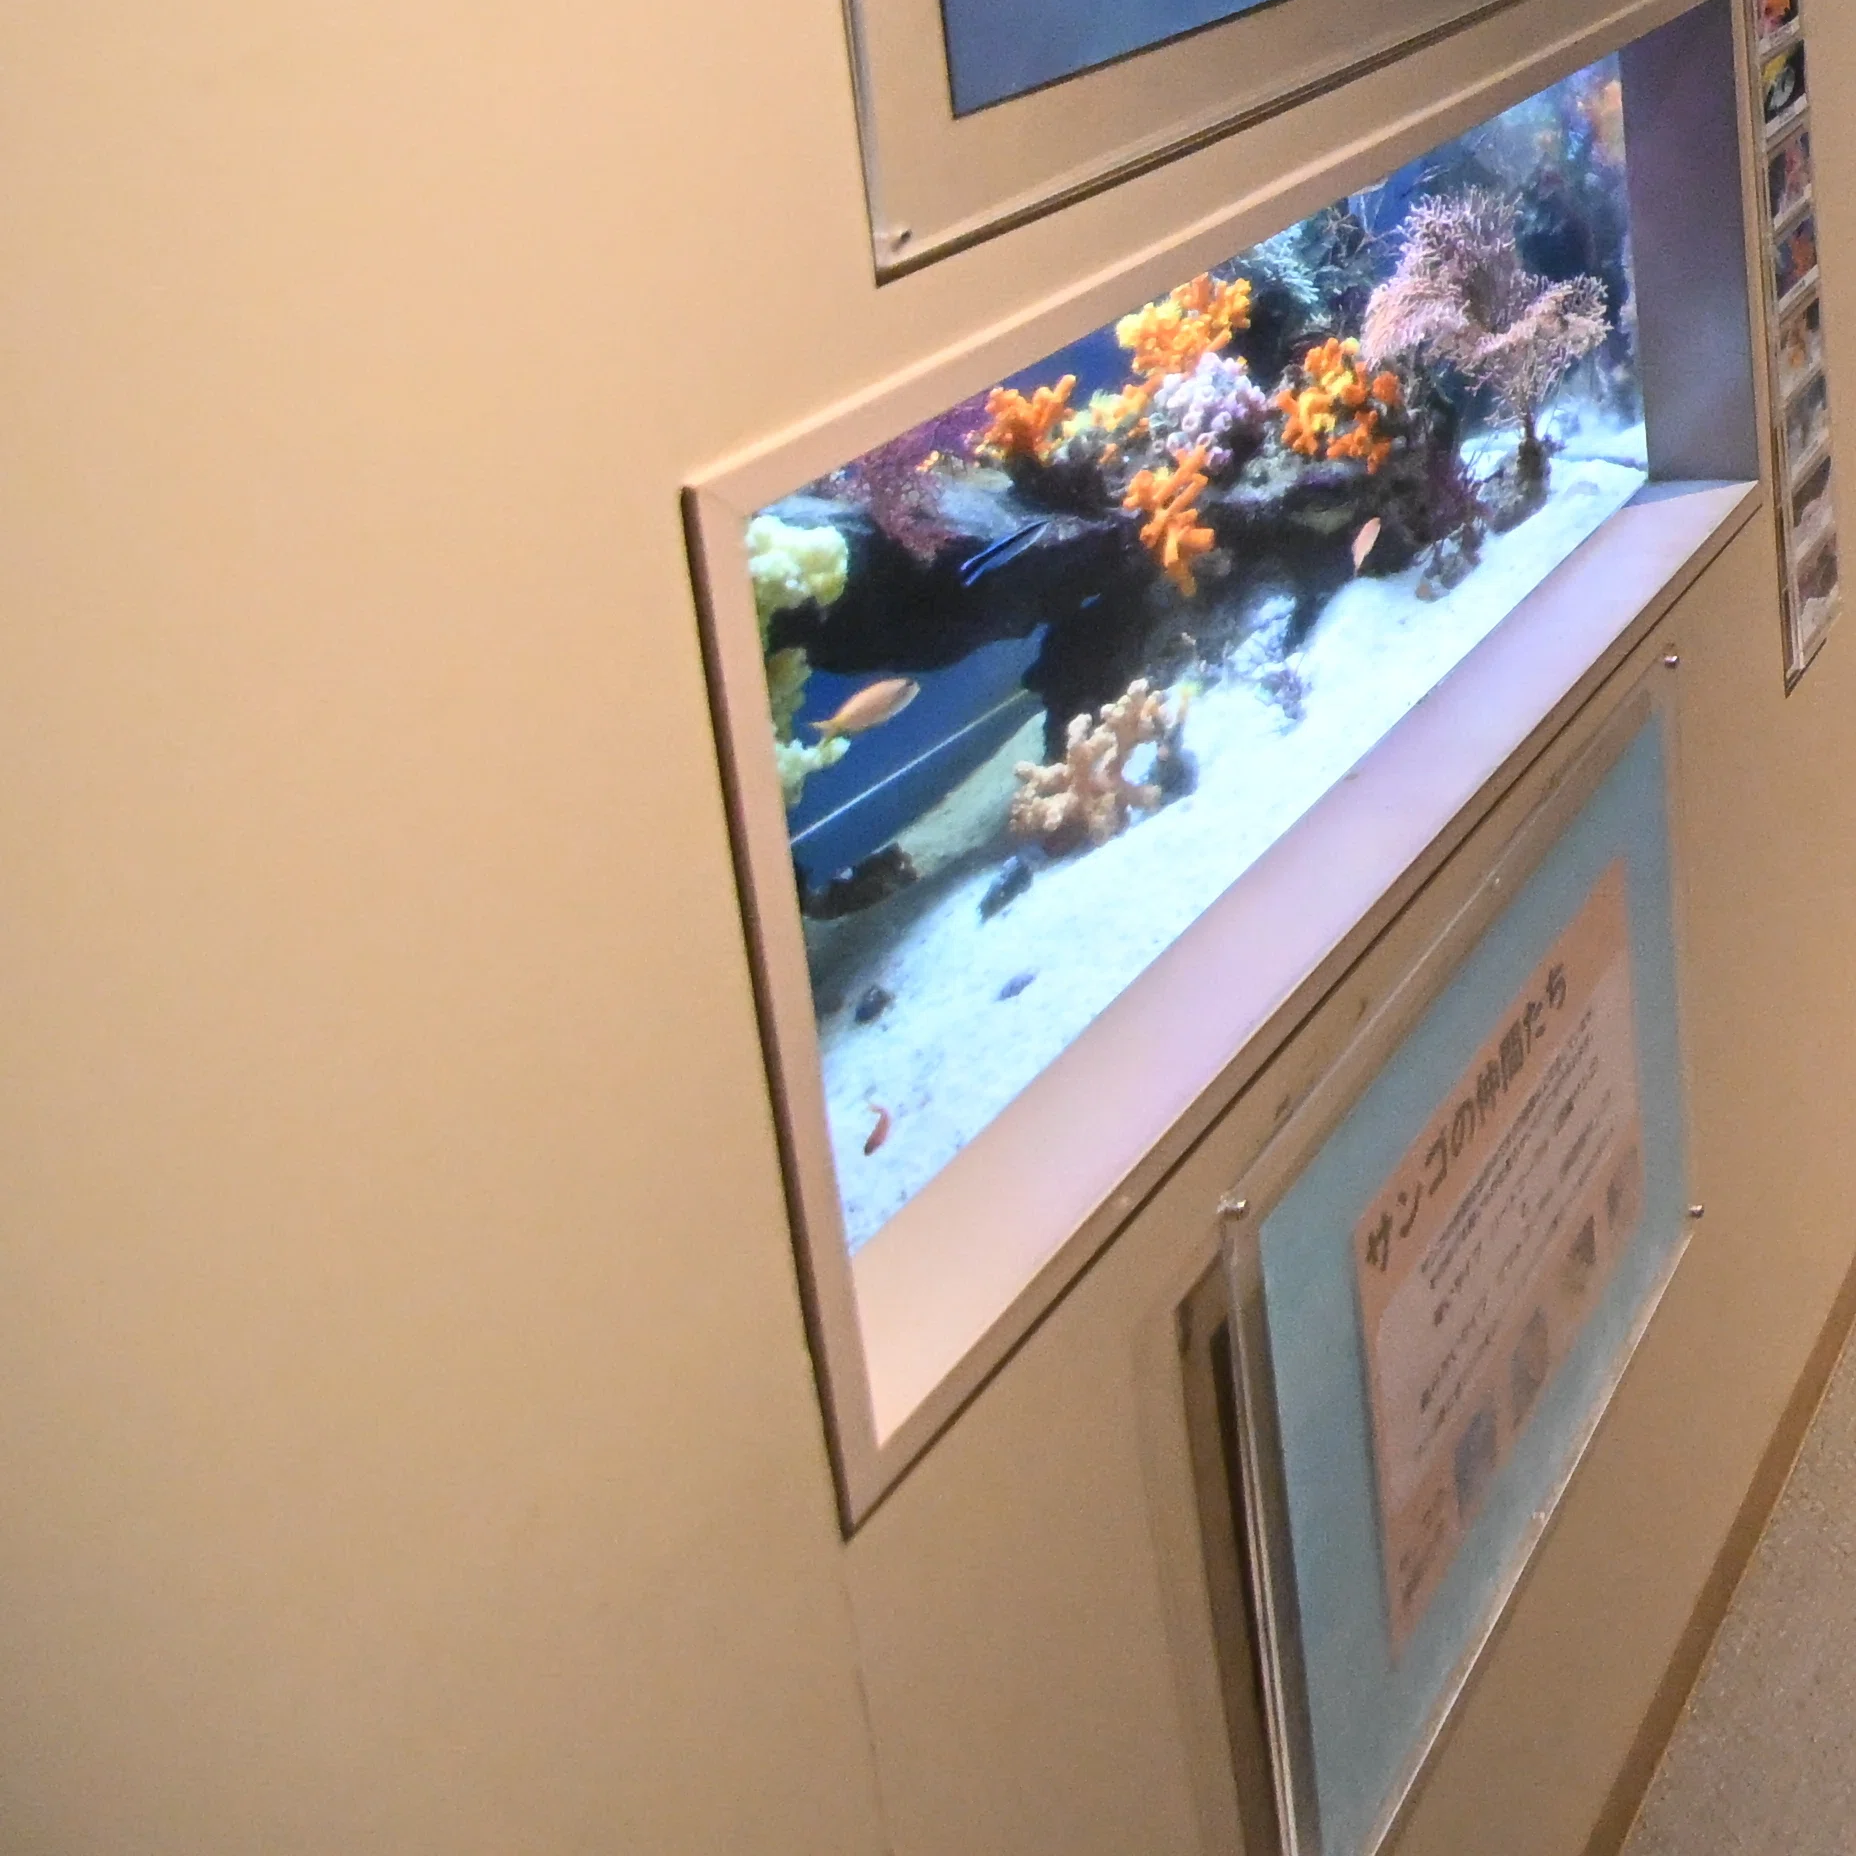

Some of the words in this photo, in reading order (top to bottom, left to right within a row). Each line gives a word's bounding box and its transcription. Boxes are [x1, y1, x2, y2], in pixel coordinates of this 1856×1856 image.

[1365, 963, 1567, 1272] サンゴの仲間たち
